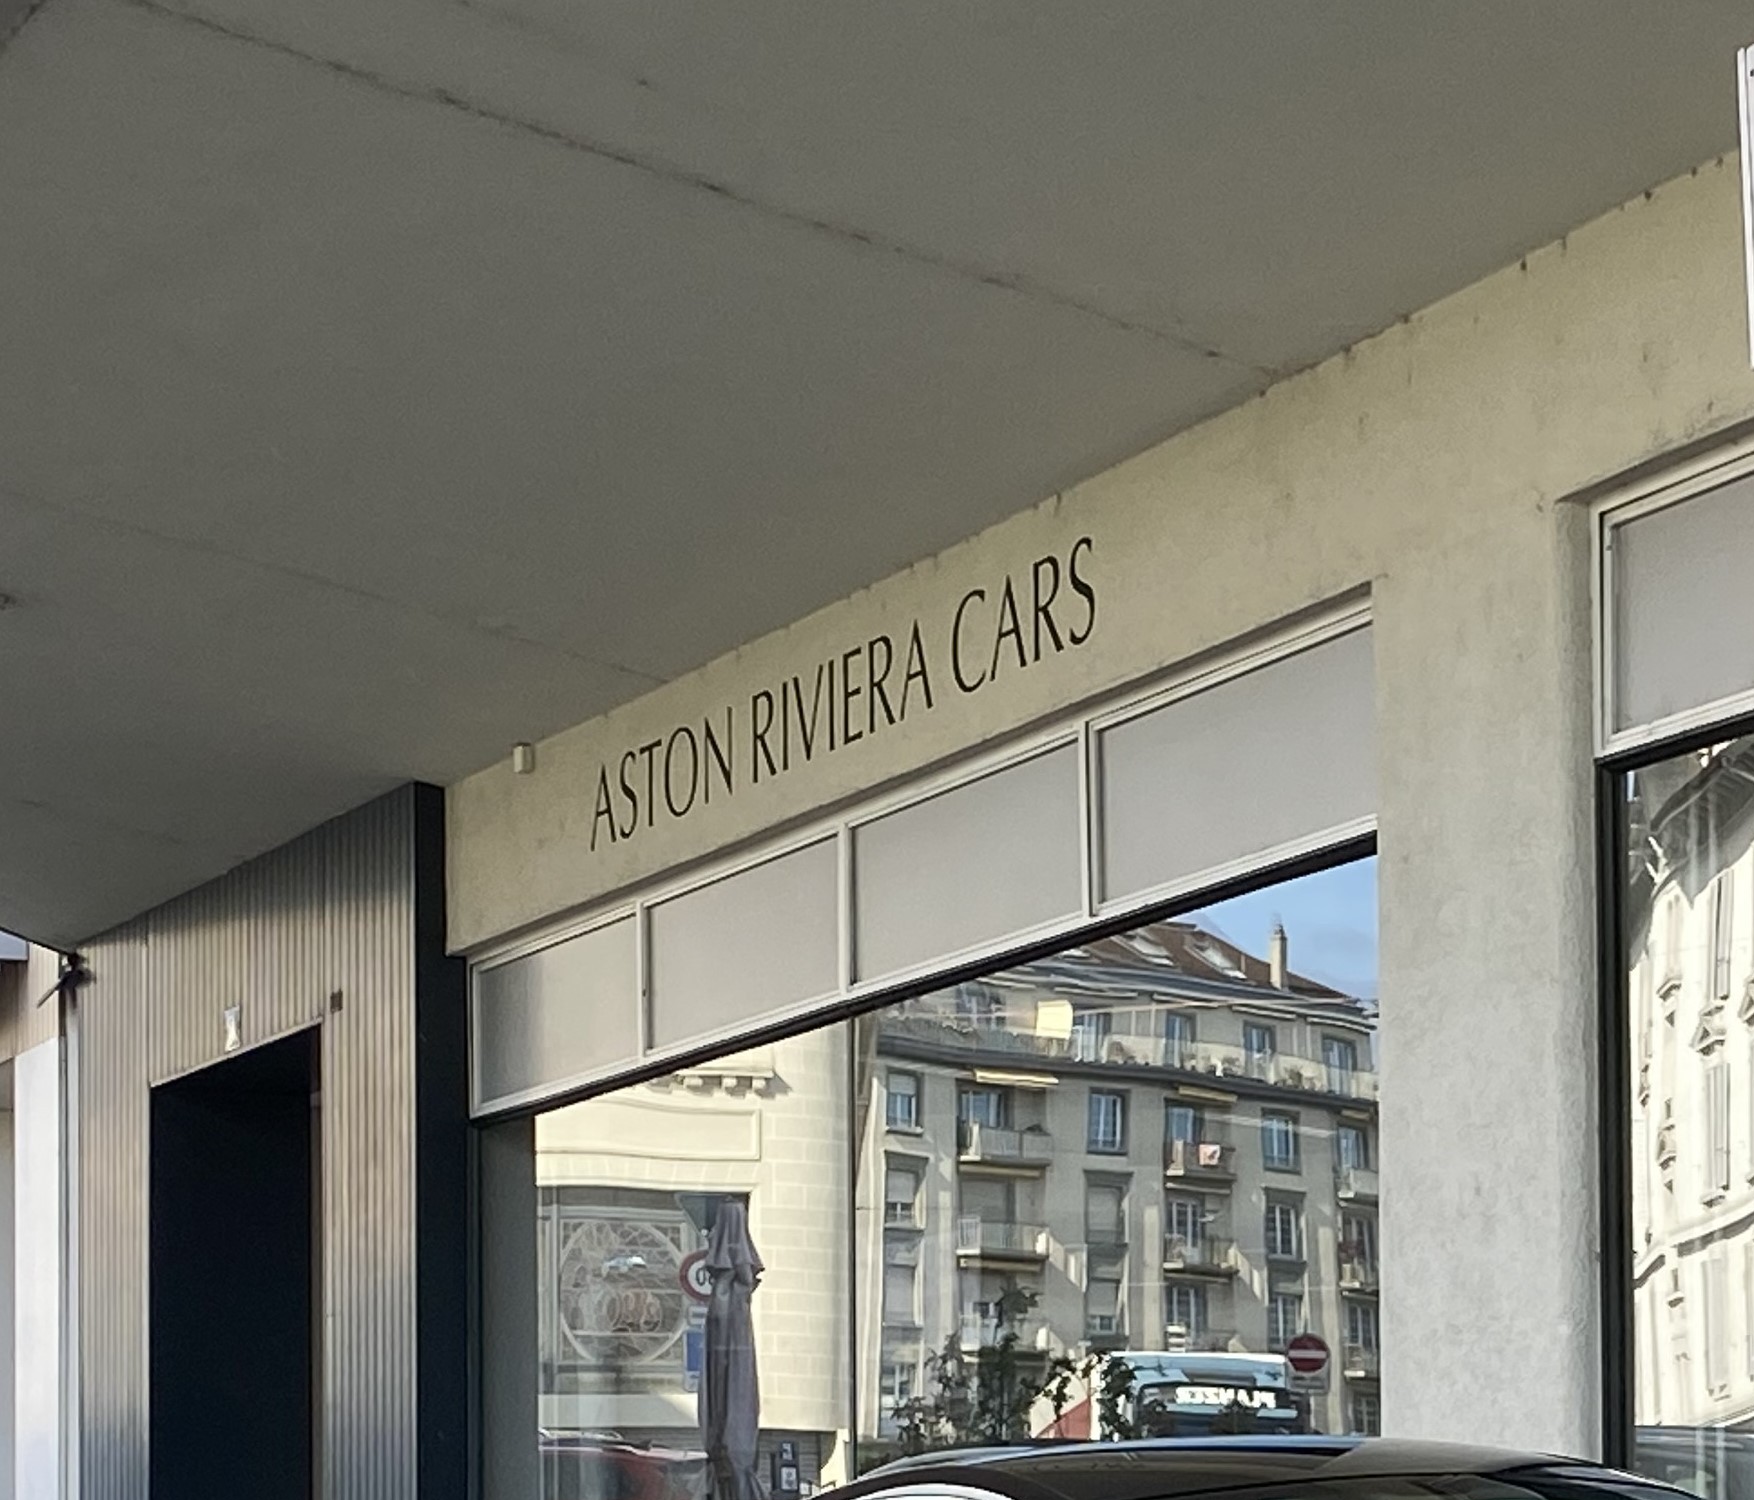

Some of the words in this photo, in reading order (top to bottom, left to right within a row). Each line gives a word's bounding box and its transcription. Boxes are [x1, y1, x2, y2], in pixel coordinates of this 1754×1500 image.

[590, 706, 733, 851] ASTON
[752, 619, 933, 784] RIVIERA
[951, 537, 1096, 693] CARS
